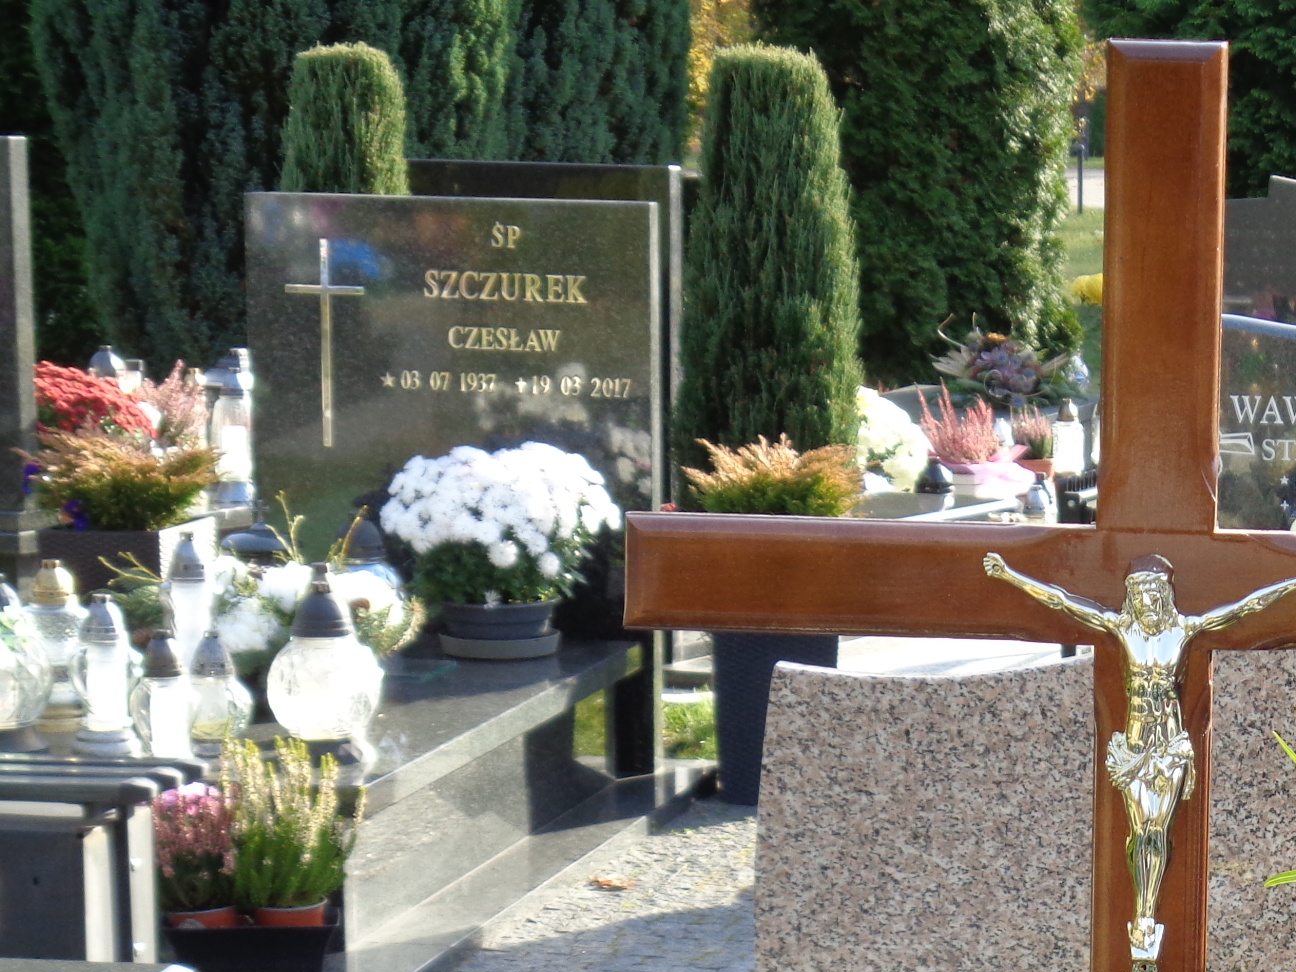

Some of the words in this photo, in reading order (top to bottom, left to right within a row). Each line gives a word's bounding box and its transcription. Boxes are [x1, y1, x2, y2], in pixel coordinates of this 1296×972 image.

[424, 269, 588, 304] SZCZUREK
[448, 325, 560, 352] CZESŁAW
[400, 370, 420, 390] 03
[429, 371, 450, 391] 07
[459, 372, 497, 392] 1937
[531, 375, 550, 395] 19
[560, 376, 581, 397] 03
[590, 377, 632, 398] 2017
